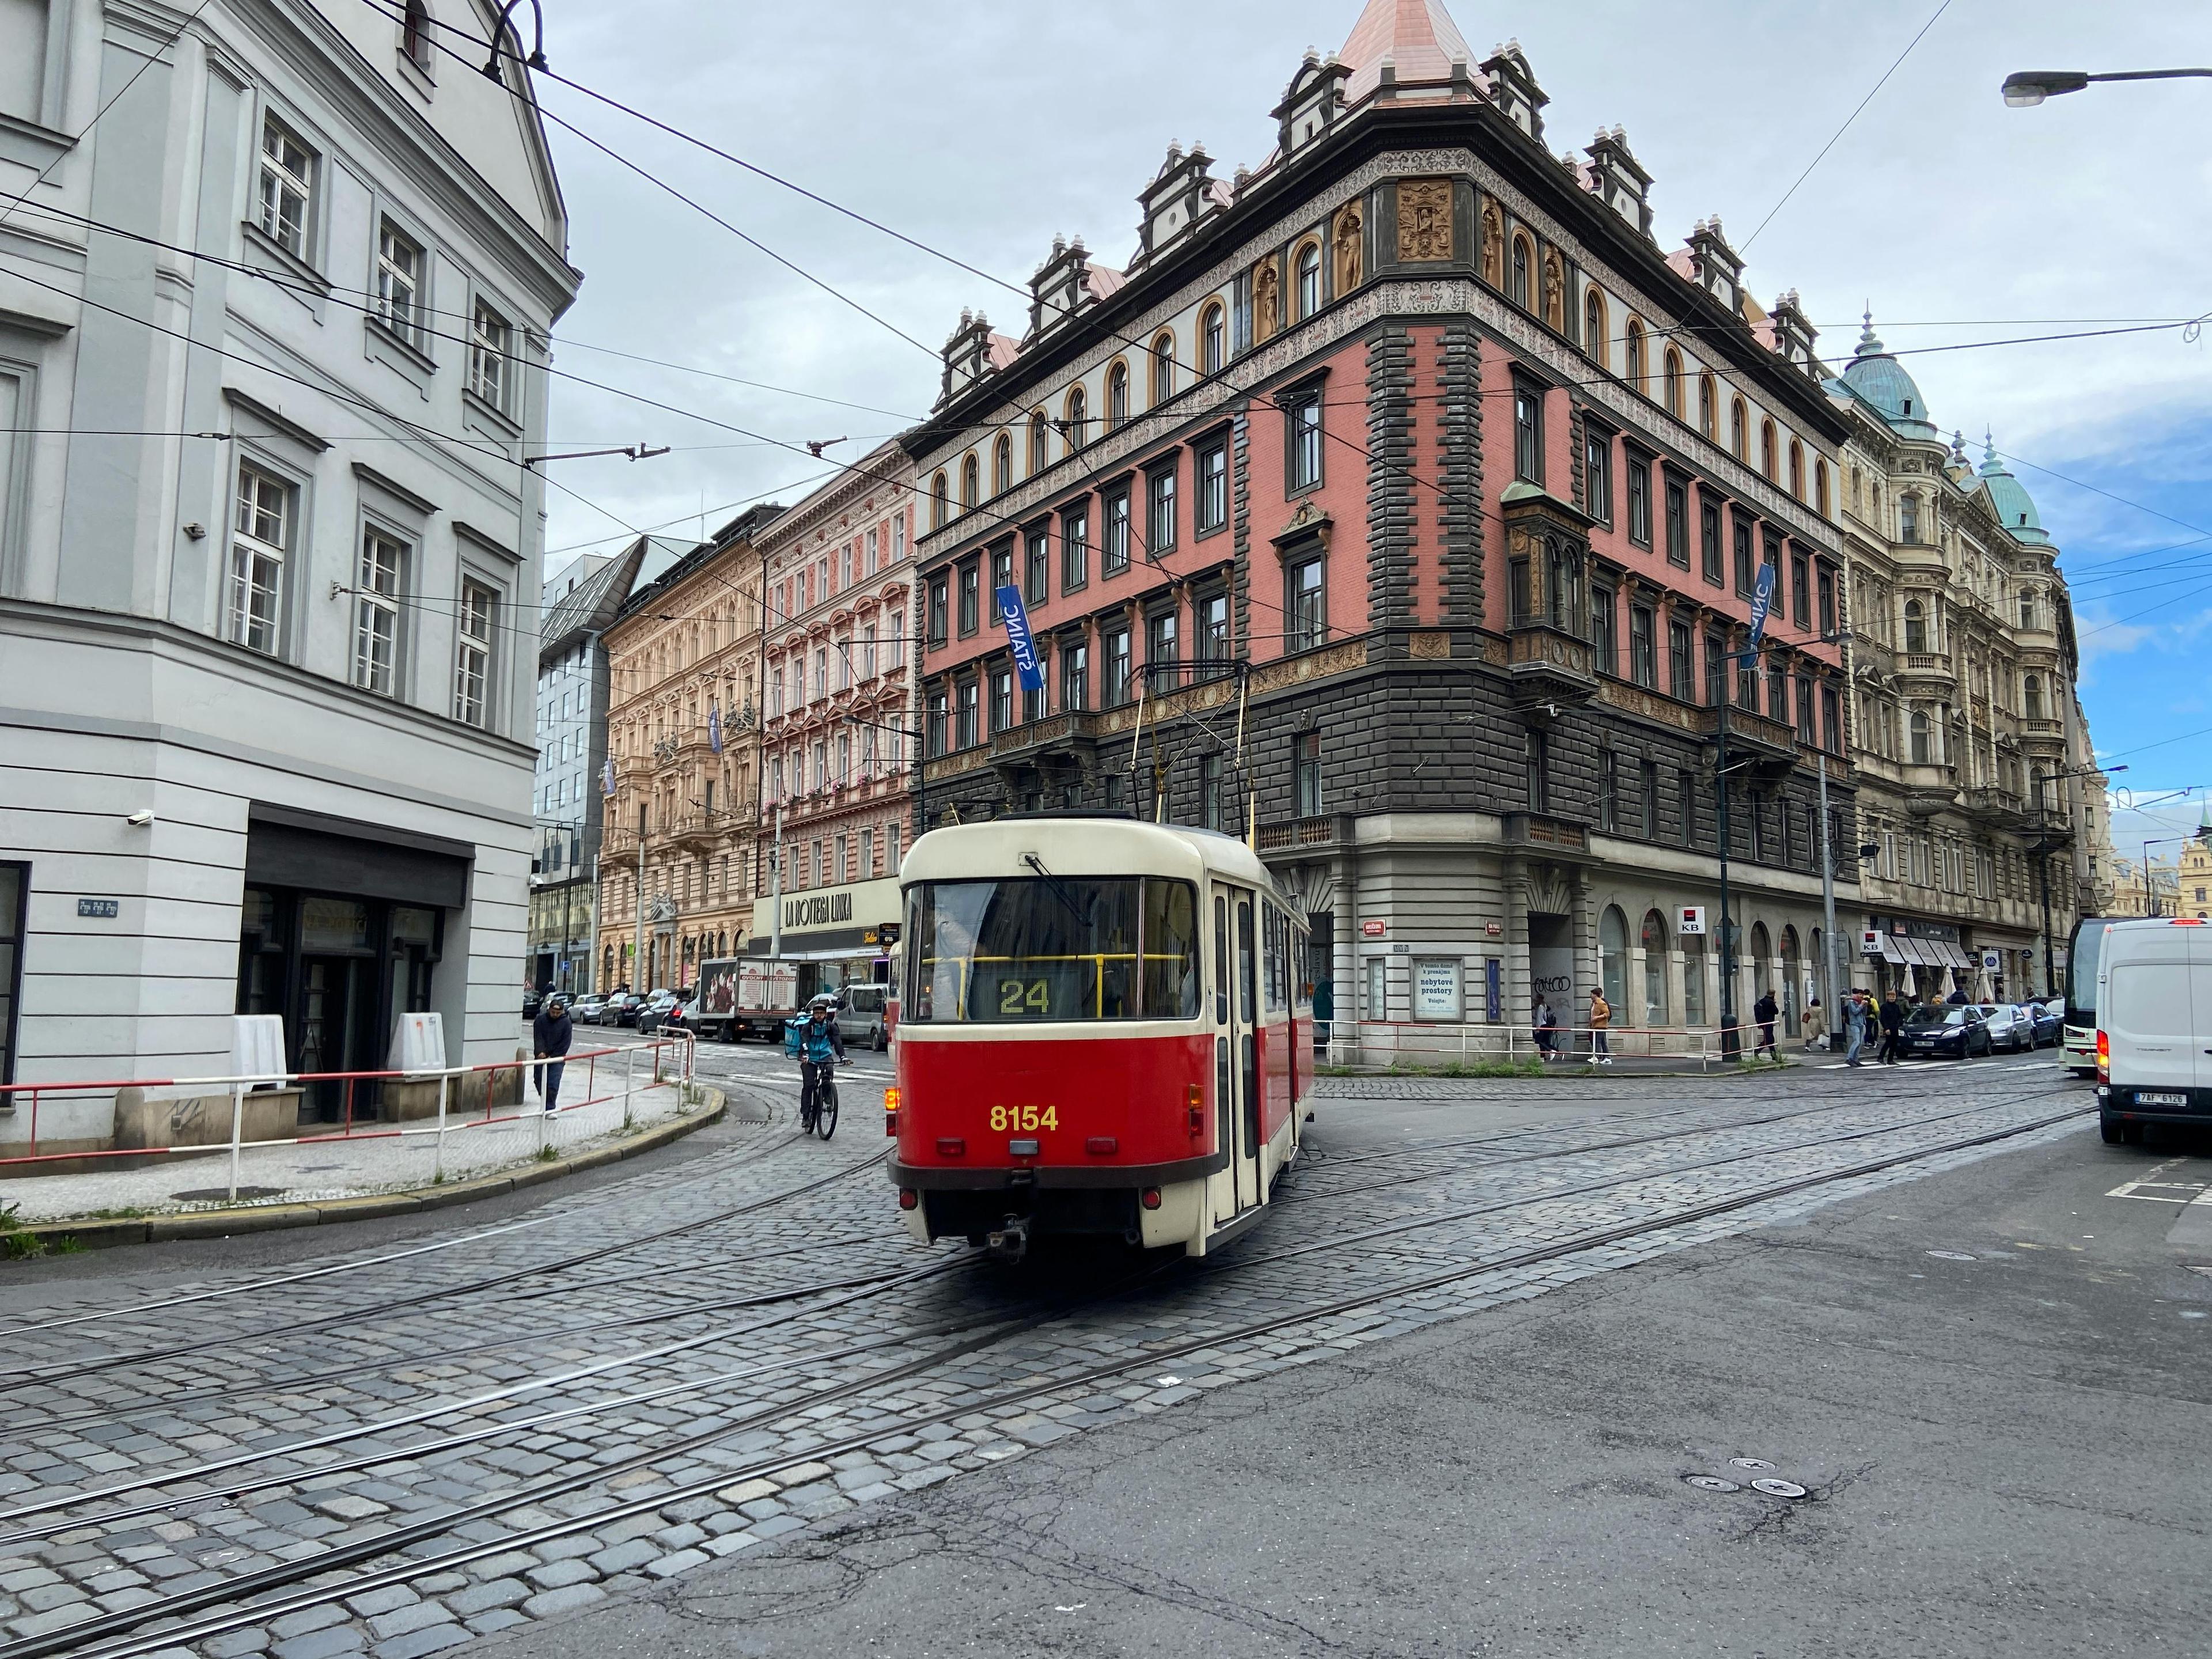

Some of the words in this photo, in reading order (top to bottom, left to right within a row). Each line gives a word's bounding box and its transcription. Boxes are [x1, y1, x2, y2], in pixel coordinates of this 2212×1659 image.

[785, 901, 794, 927] LA
[795, 896, 830, 926] BOTTEGA
[1421, 978, 1453, 987] nebytové
[1421, 987, 1453, 995] prostory
[1001, 979, 1048, 1013] 24
[990, 1105, 1058, 1131] 8154
